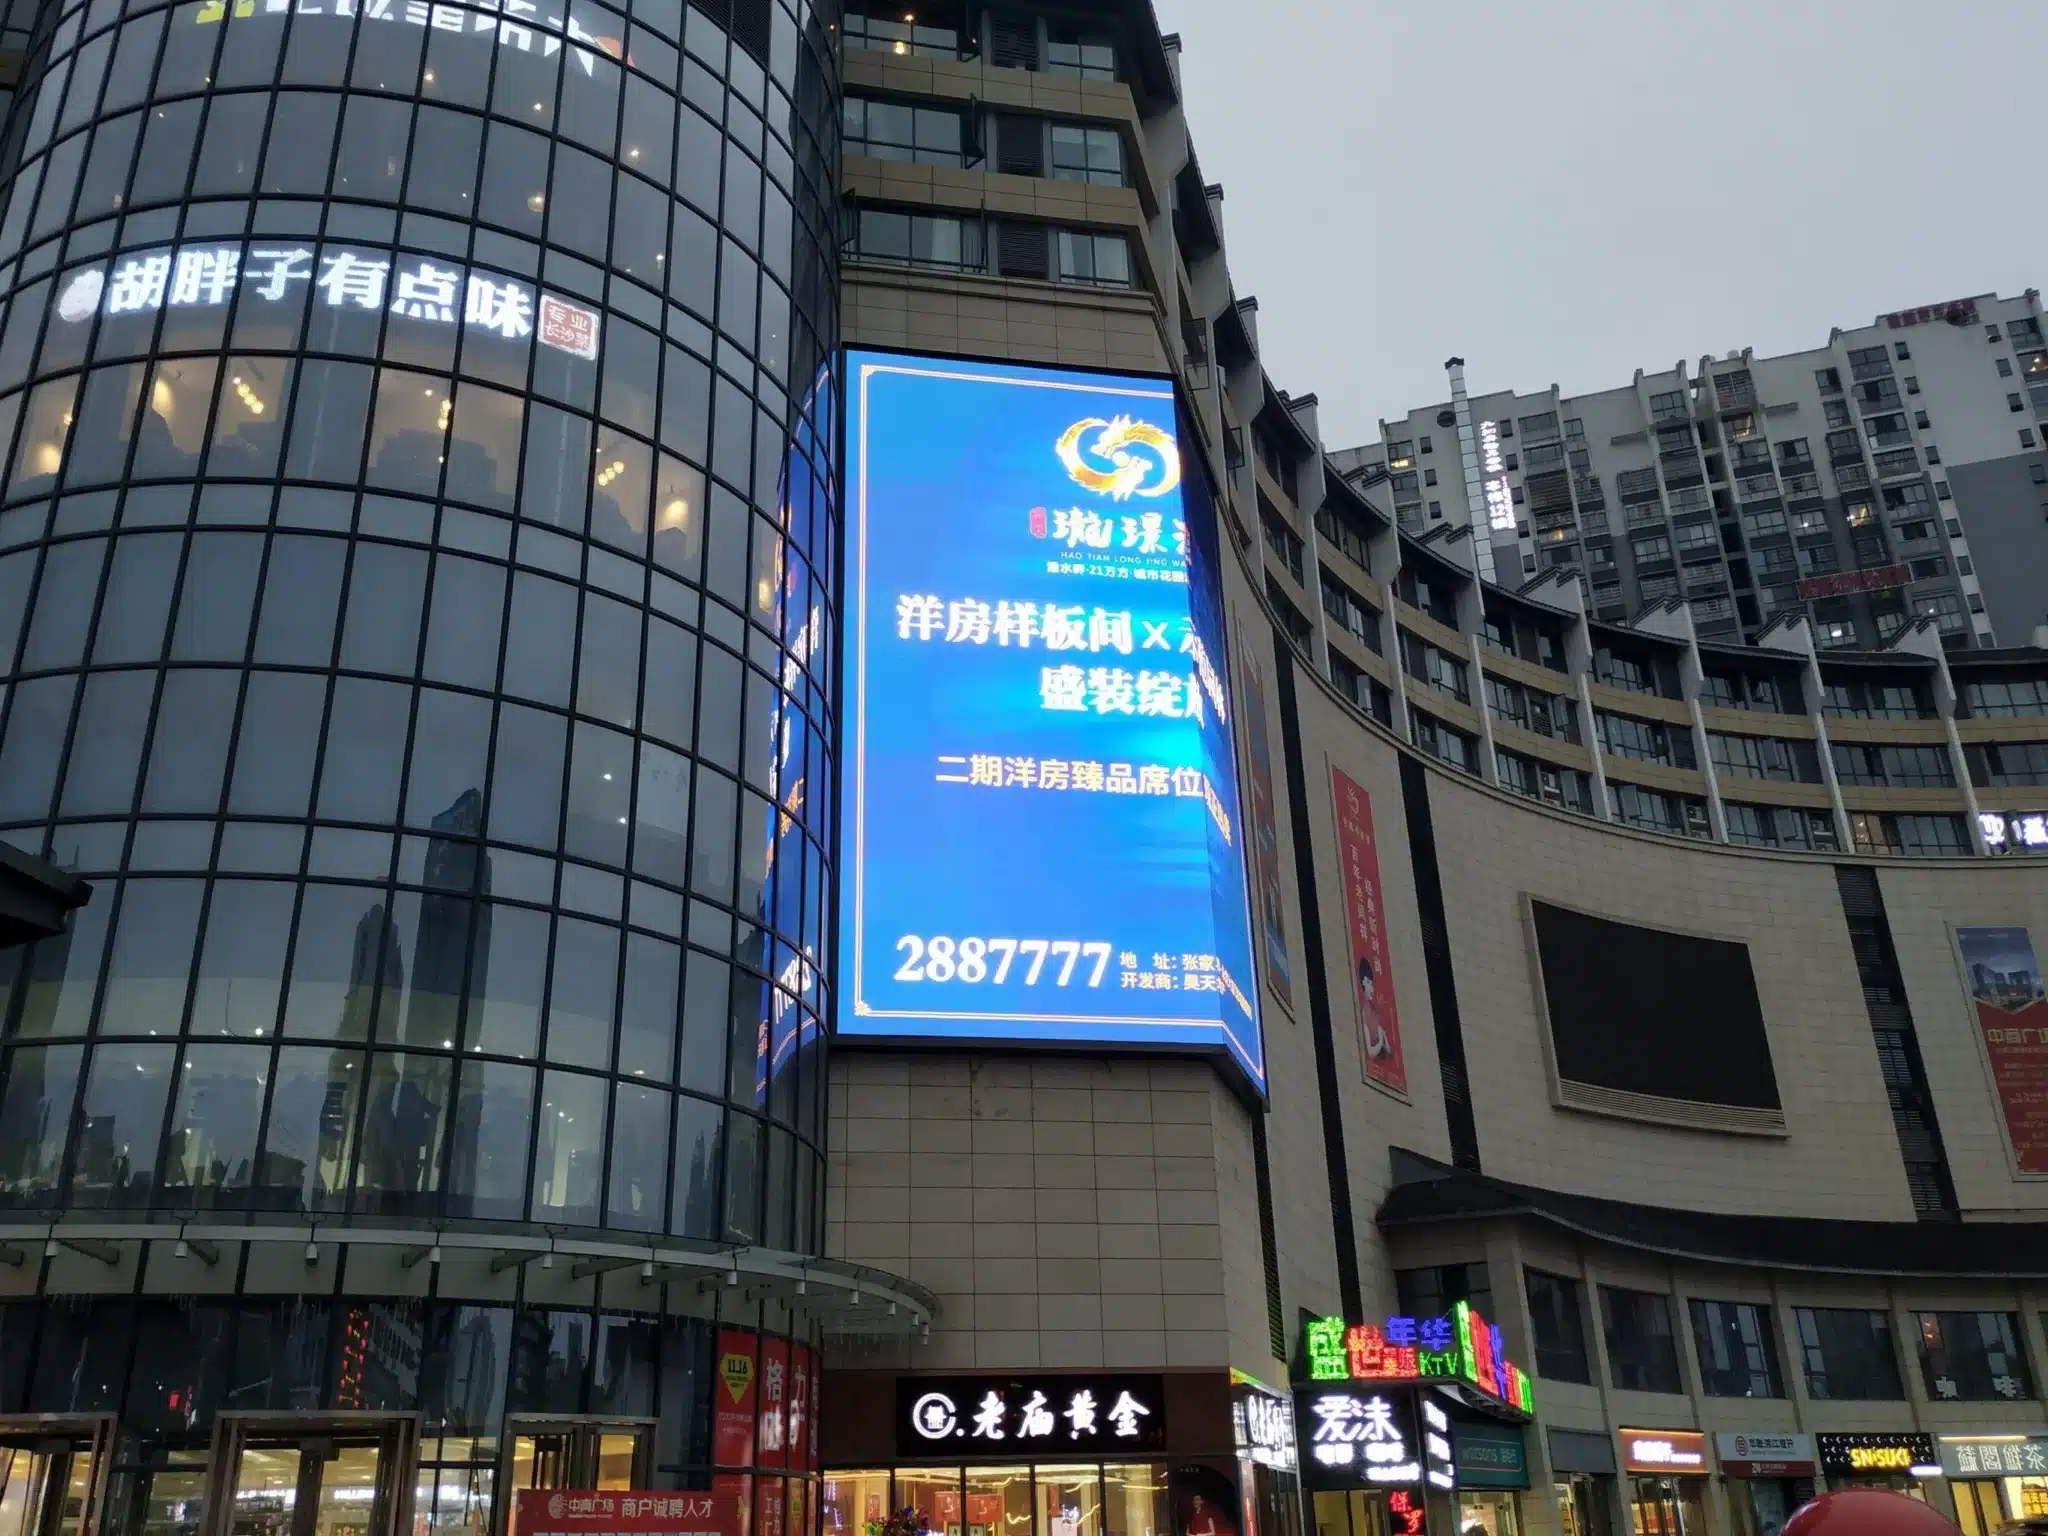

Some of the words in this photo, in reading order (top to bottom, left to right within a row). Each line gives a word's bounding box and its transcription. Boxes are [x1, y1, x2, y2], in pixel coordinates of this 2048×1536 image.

[109, 246, 533, 338] 胡胖子有点味
[1060, 551, 1083, 560] HAO
[1114, 555, 1141, 564] LONG
[893, 934, 1112, 989] 2887777
[1419, 1351, 1458, 1376] KTV
[972, 1388, 1150, 1440] 老庙黄金
[621, 1498, 714, 1519] 商户诚聘人才
